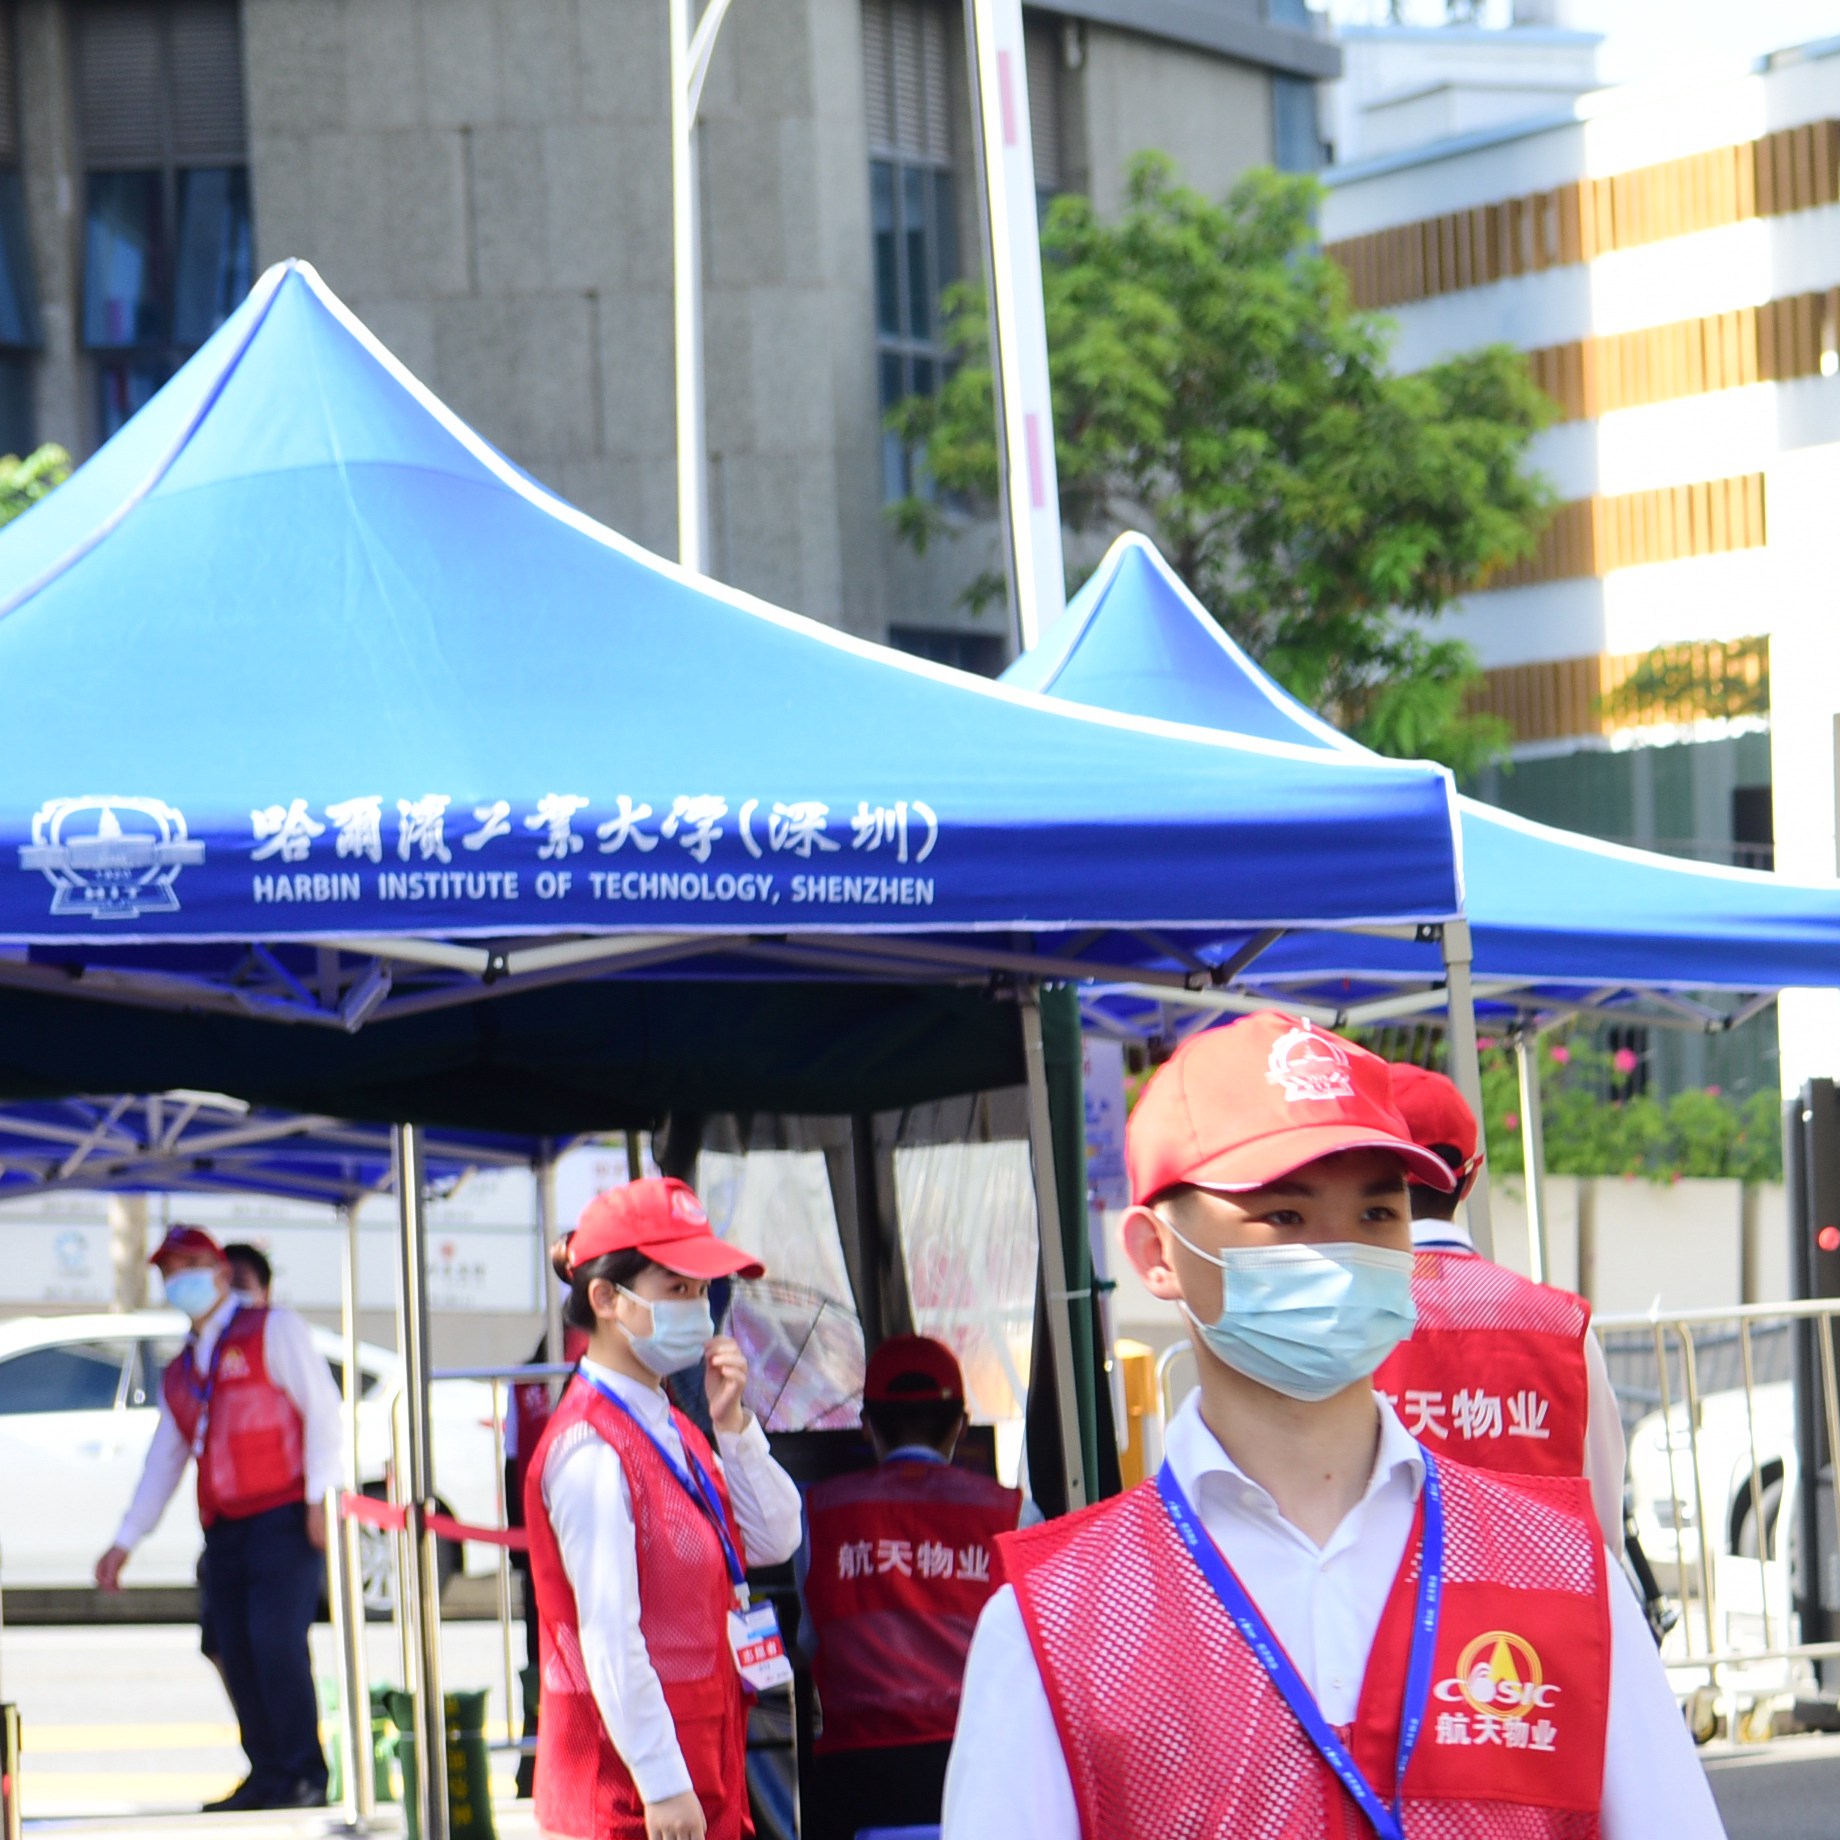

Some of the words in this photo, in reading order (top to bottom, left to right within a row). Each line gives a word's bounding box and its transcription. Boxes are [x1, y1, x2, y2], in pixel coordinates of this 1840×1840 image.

[252, 872, 360, 903] HARBIN
[378, 872, 518, 900] INSTITUTE
[536, 872, 572, 899] OF
[589, 872, 780, 905] TECHNOLOGY,
[791, 875, 934, 905] SHENZHEN
[1380, 1388, 1550, 1440] 天物业
[839, 1539, 989, 1582] 航天物业
[1434, 1712, 1557, 1751] 航天物业
